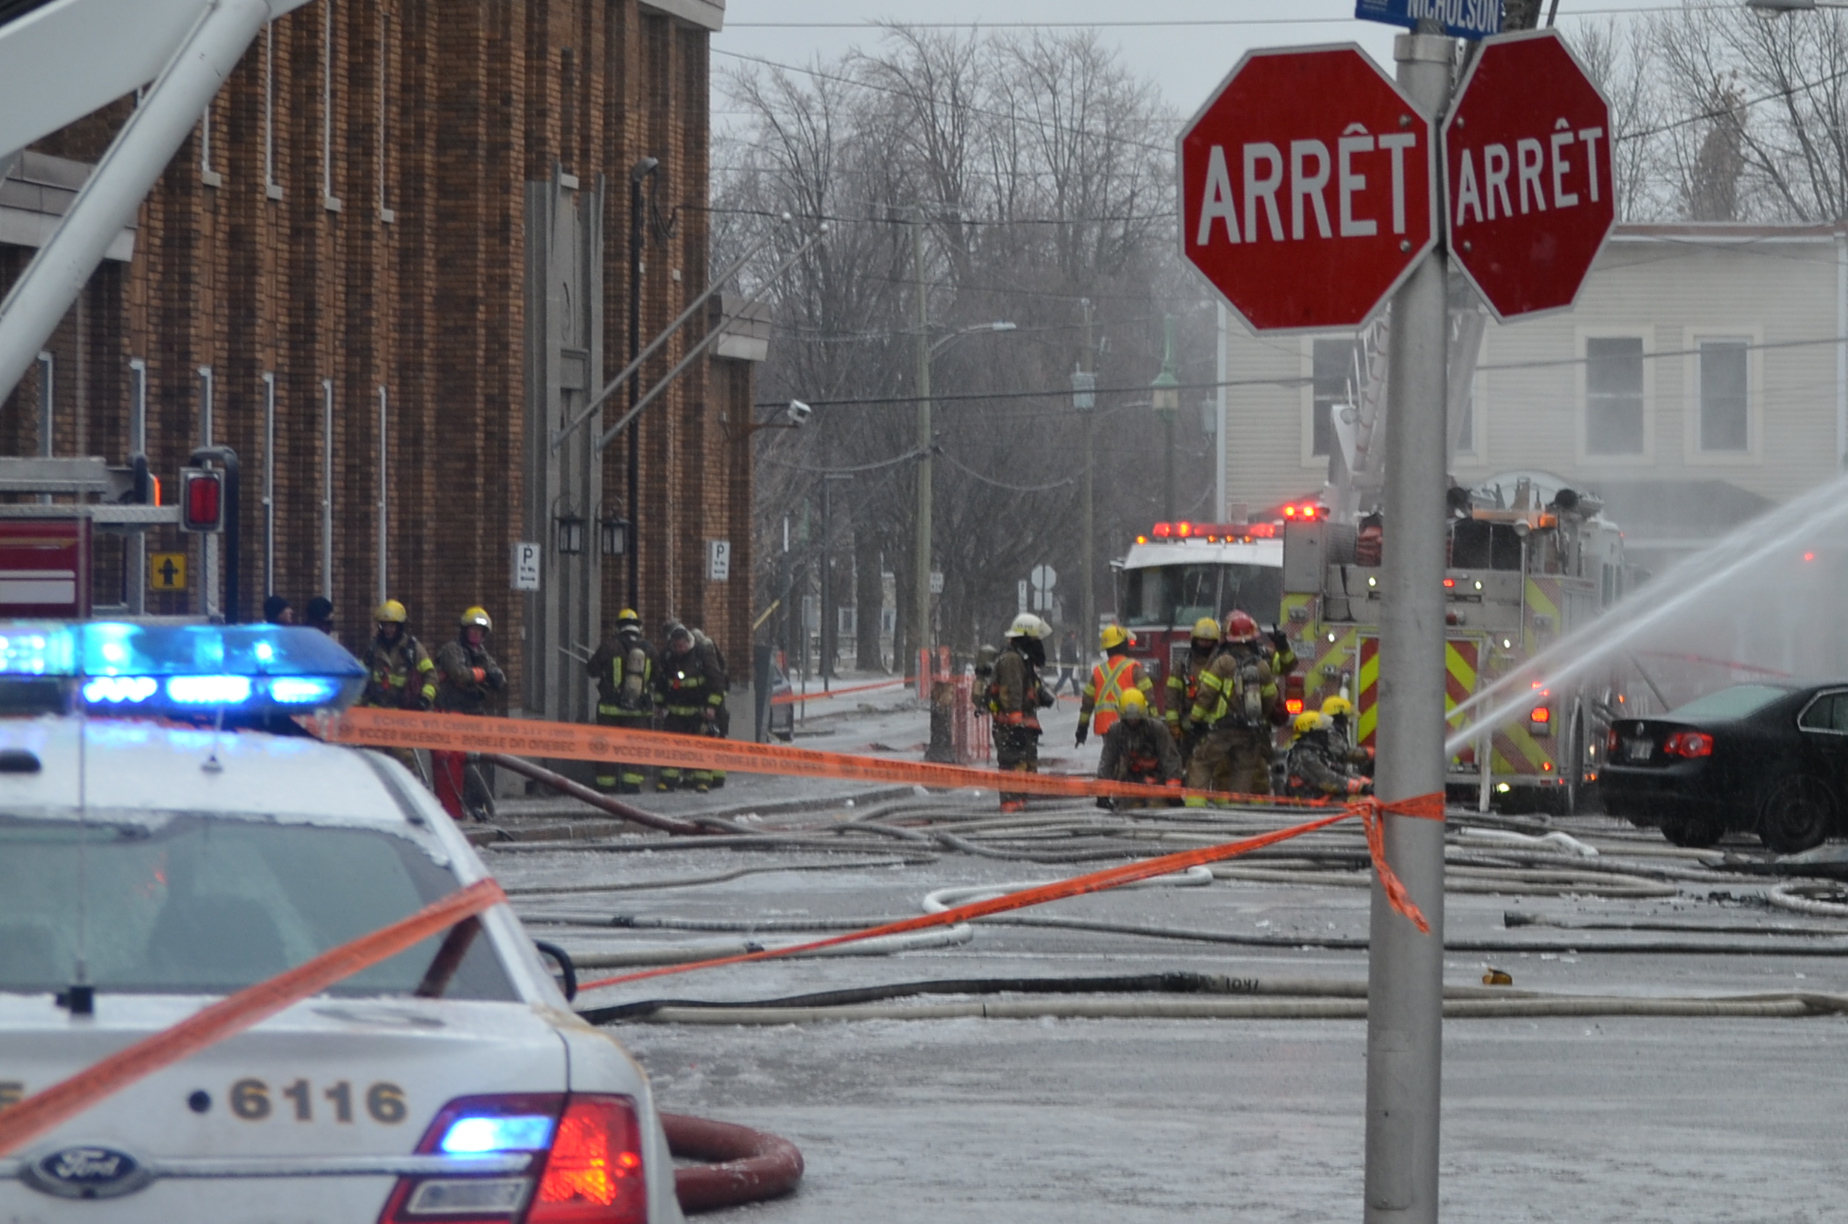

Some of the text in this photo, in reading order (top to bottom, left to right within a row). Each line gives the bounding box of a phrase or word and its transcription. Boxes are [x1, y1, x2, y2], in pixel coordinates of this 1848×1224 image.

[1197, 122, 1416, 246] ARRÊT
[1456, 117, 1603, 227] ARRÊT
[524, 547, 533, 564] P
[228, 1077, 408, 1125] 6116
[55, 1149, 121, 1178] Ford
